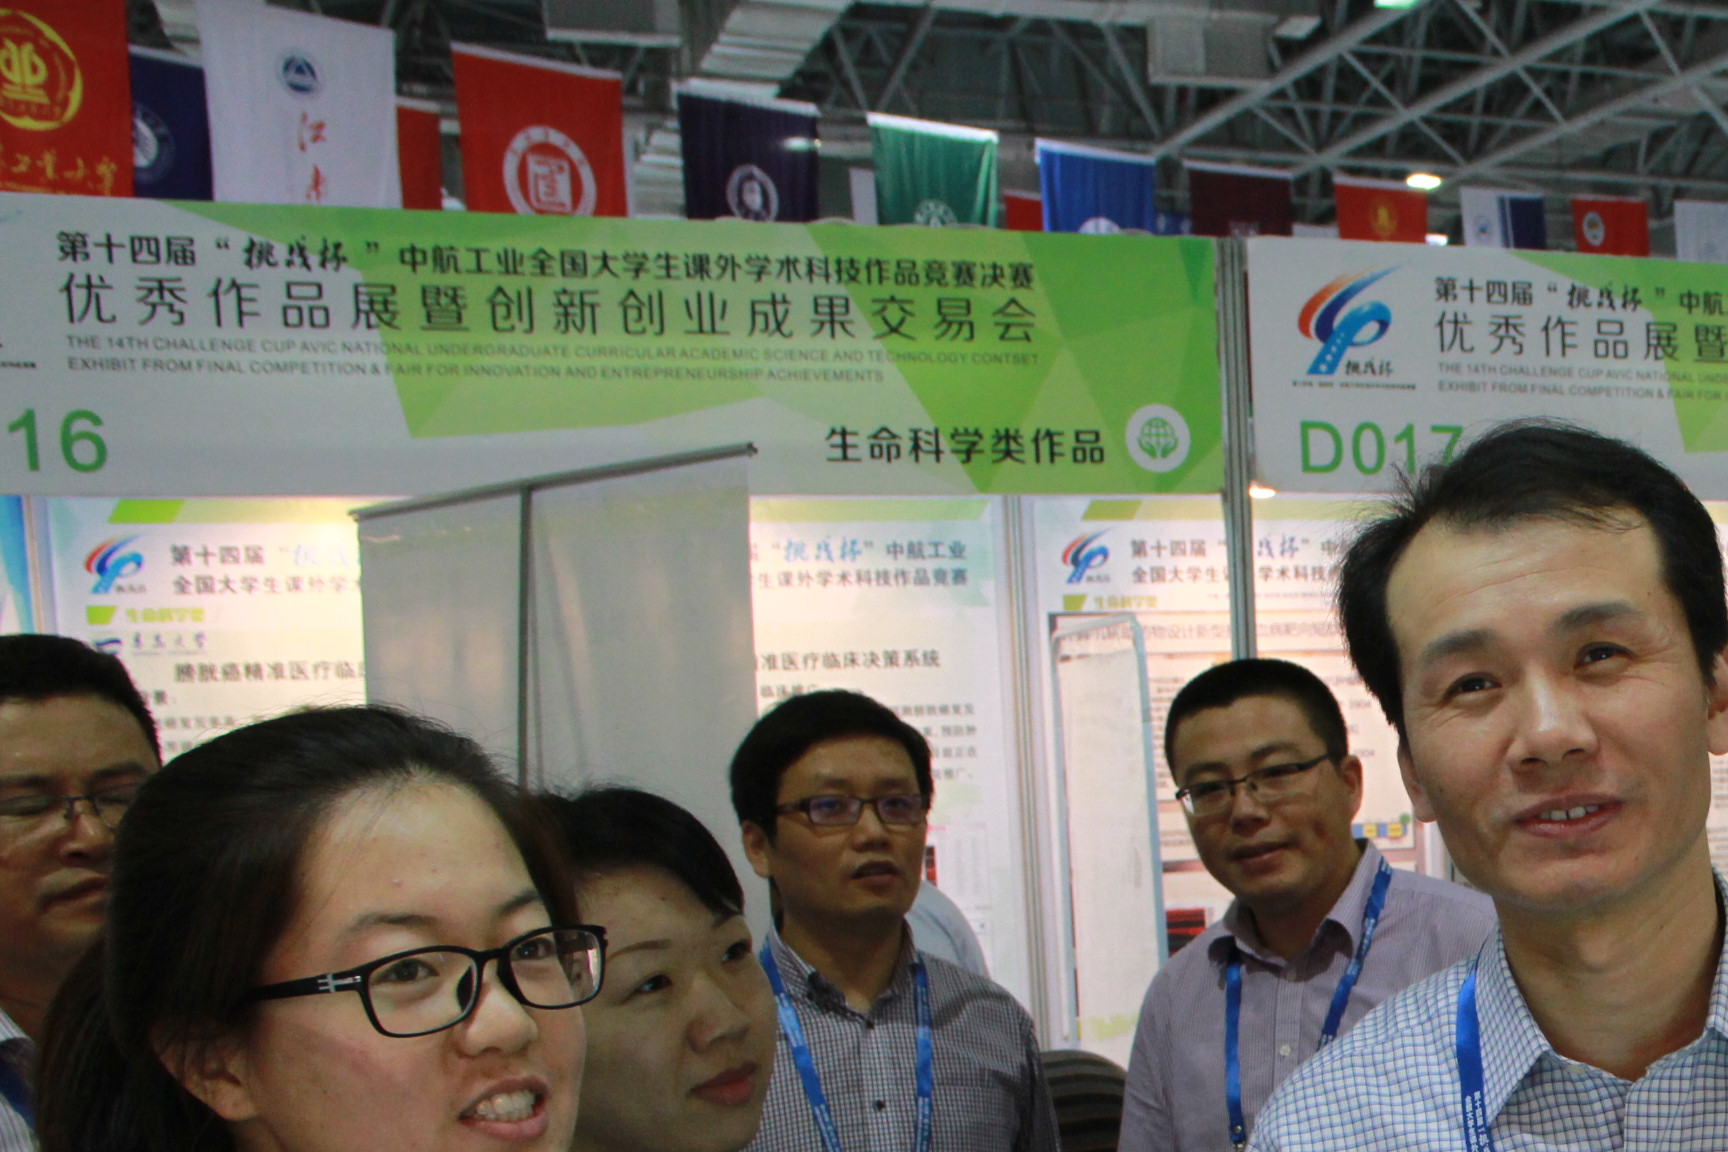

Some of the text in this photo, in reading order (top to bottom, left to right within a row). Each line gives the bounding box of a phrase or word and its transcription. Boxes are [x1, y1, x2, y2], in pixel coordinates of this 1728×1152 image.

[58, 272, 1036, 343] 优秀作品展暨创新创业成果交易会
[66, 335, 100, 350] THE
[107, 337, 149, 351] 14TH
[153, 338, 257, 353] CHALLENGE
[262, 340, 297, 353] CUP
[300, 341, 340, 354] AVIC
[343, 342, 423, 357] NATIONAL
[425, 344, 572, 359] UNDERGRADUATE
[574, 346, 677, 360] CURRICULAR
[679, 348, 759, 362] ACADEMIC
[764, 349, 829, 363] SCIENCE
[833, 350, 865, 364] AND
[868, 350, 966, 366] TECHNOLOGY
[67, 358, 885, 384] EXHIBIT FROM FINAL COMPETITION & FAIR FOR INNOVATION AND ENTREPRENEURSHIP ACHIEVEMENTS
[1437, 362, 1461, 374] THE
[1466, 363, 1498, 375] 14TH
[1499, 365, 1574, 378] CHALLENGE
[1578, 367, 1604, 379] CUP
[1605, 368, 1633, 380] AVIC
[1437, 380, 1488, 393] EXHIBIT
[1490, 381, 1528, 394] FROM
[1530, 382, 1565, 396] FINAL
[1568, 384, 1655, 399] COMPETITION
[825, 425, 1105, 464] 生命科学类作品
[1299, 420, 1464, 476] D017
